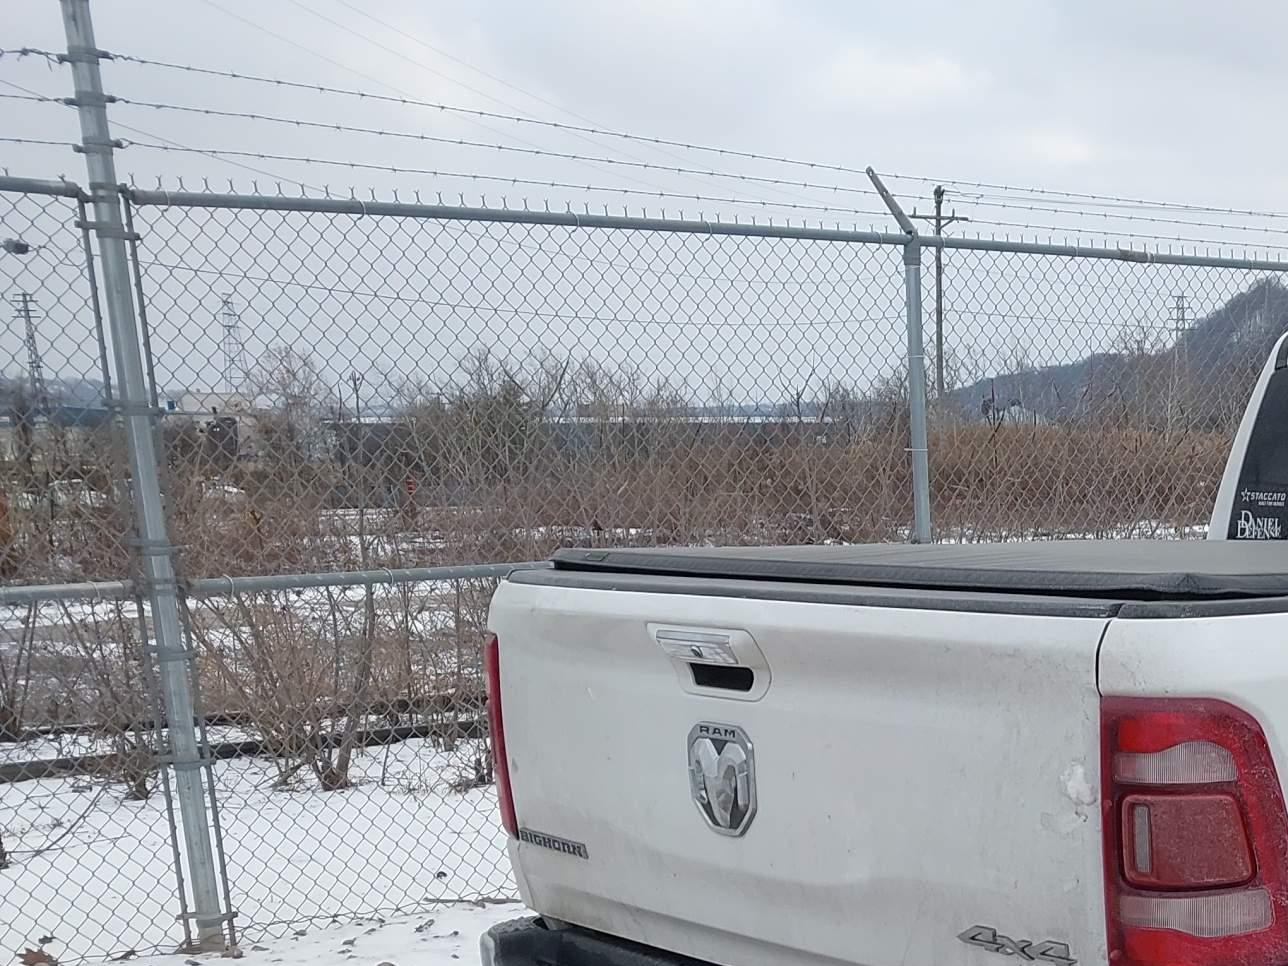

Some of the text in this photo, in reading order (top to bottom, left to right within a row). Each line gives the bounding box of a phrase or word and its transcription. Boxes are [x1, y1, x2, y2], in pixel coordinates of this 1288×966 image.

[1250, 491, 1287, 501] STACCATO
[1241, 510, 1279, 530] DANIEL
[699, 725, 736, 738] RAM
